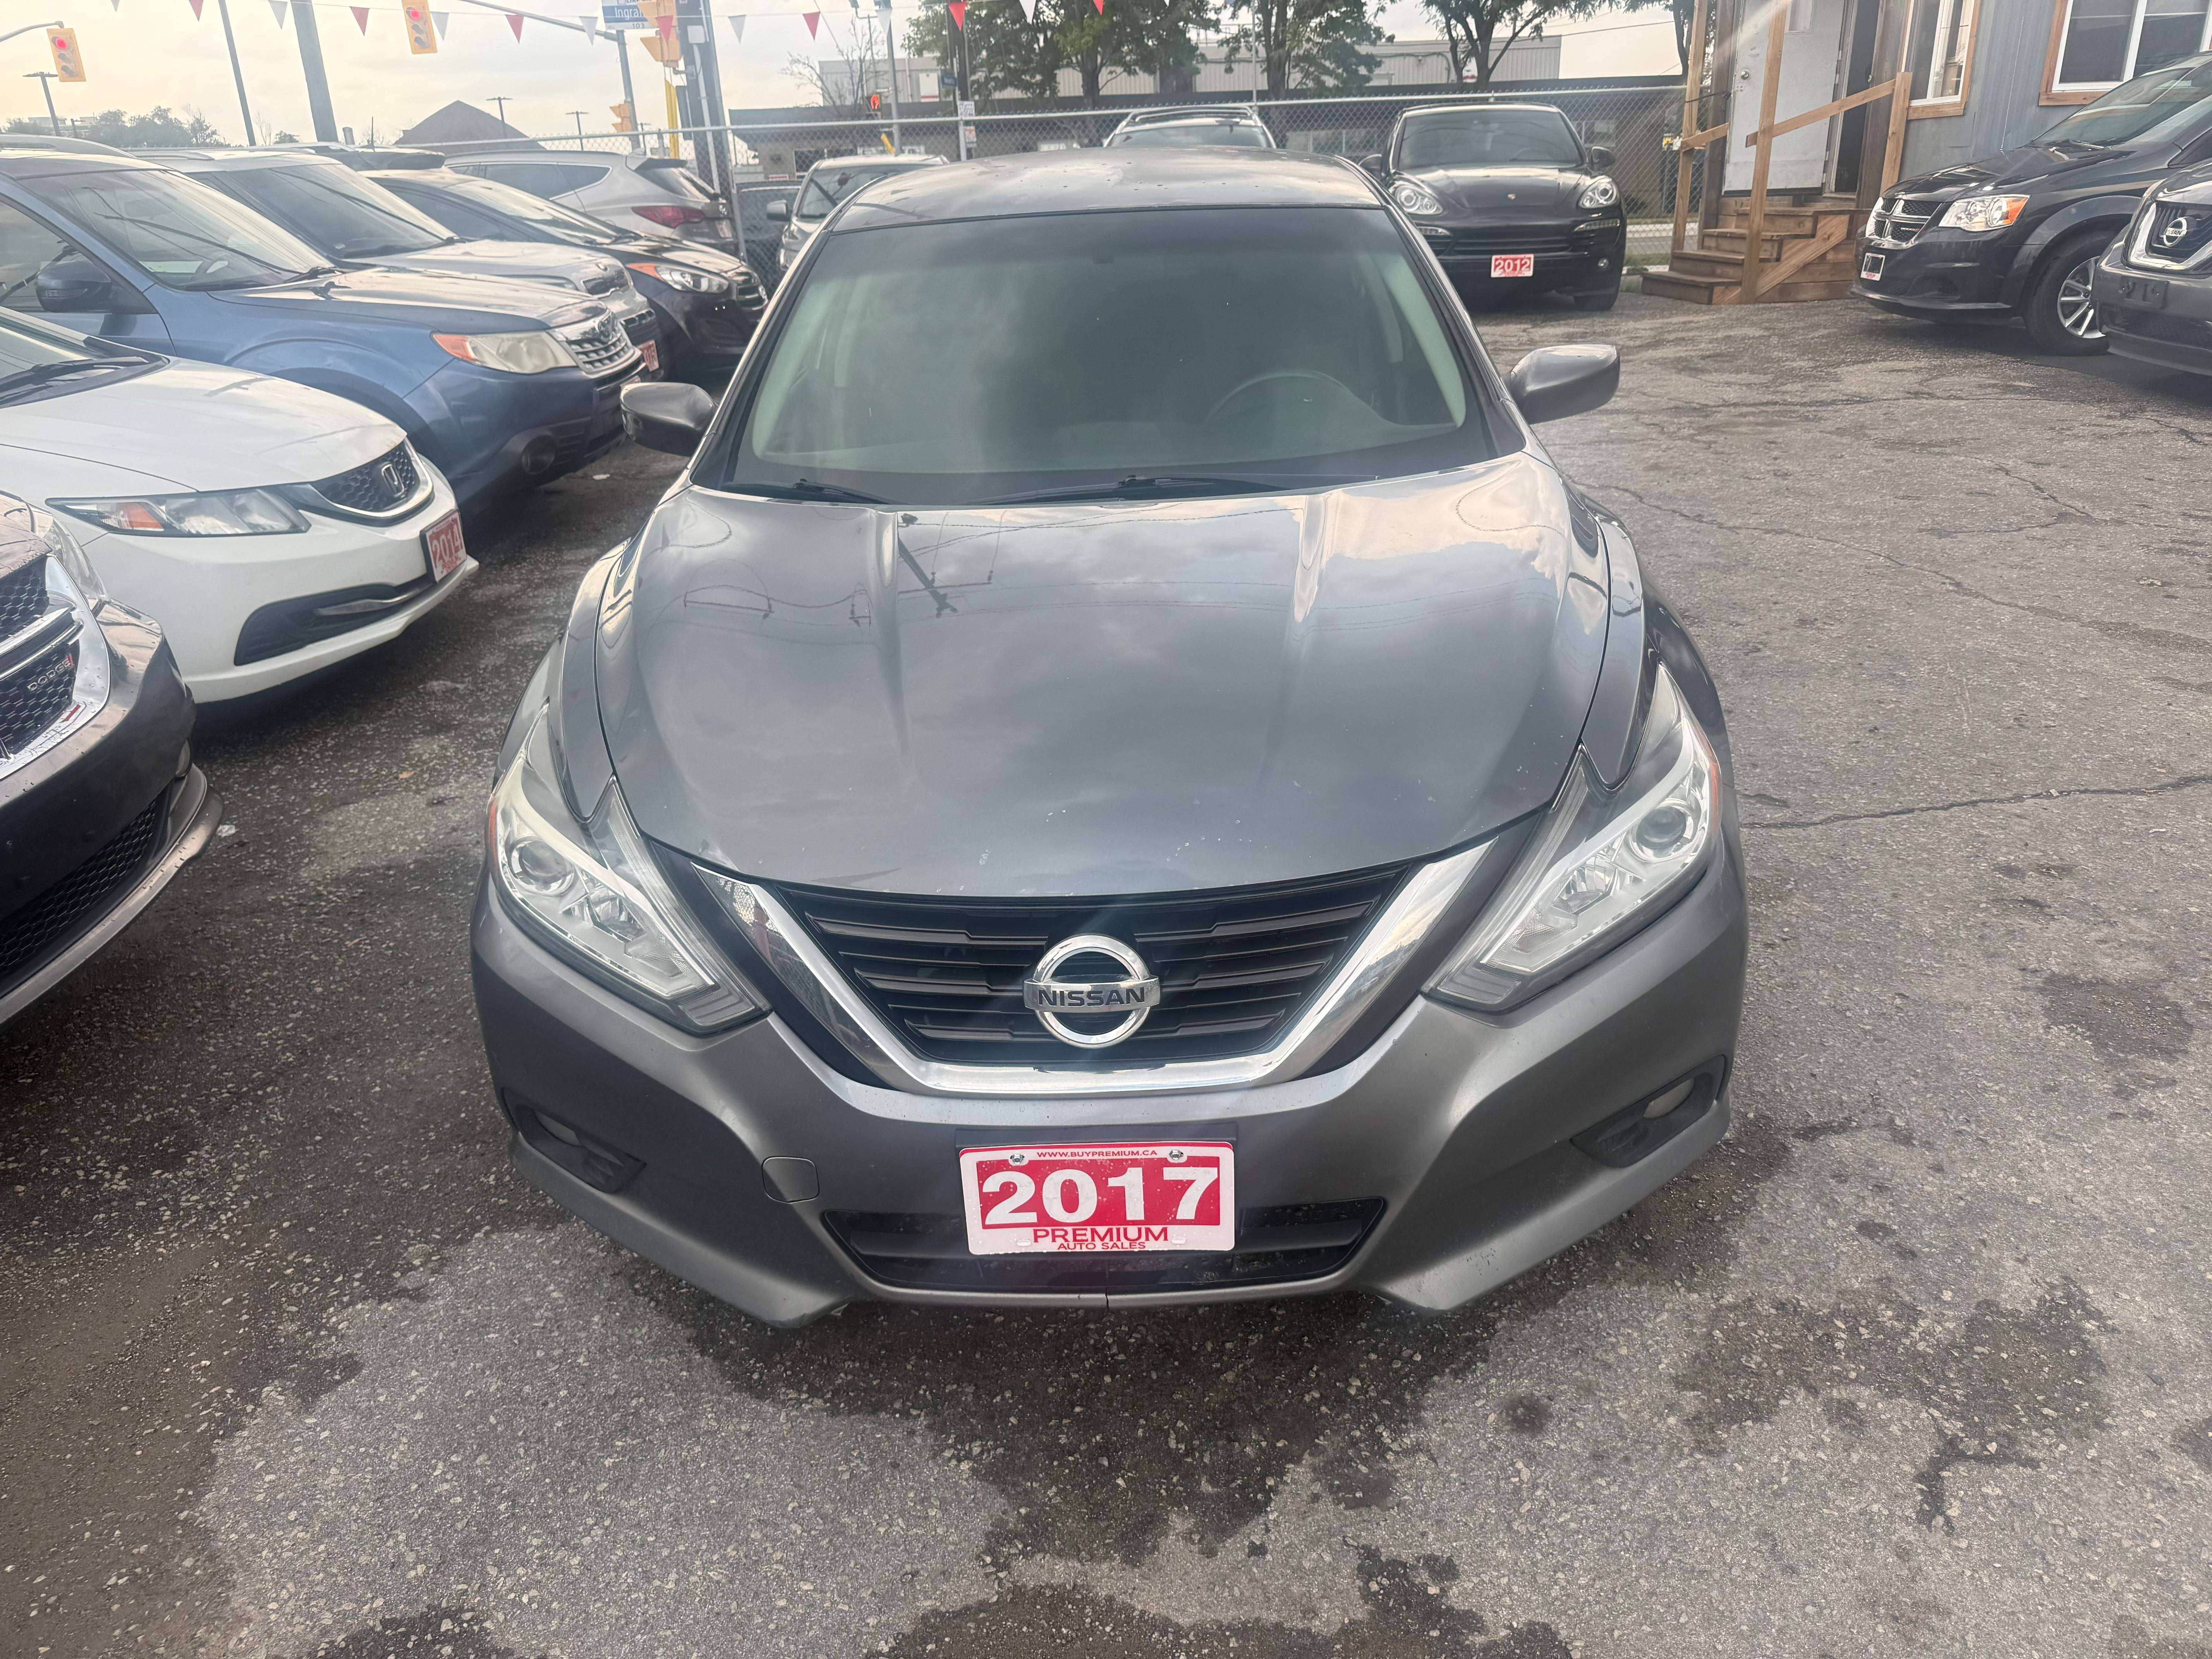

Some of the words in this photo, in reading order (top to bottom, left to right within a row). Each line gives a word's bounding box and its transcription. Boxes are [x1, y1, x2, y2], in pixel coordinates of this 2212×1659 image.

[614, 7, 644, 20] Ingra
[1495, 259, 1530, 272] 2012
[432, 524, 462, 568] 2014
[27, 659, 71, 691] DODGE
[1038, 987, 1145, 1007] NISSAN
[982, 1167, 1218, 1225] 2017
[1033, 1227, 1168, 1243] PREMIUM
[1101, 1242, 1146, 1250] SALES
